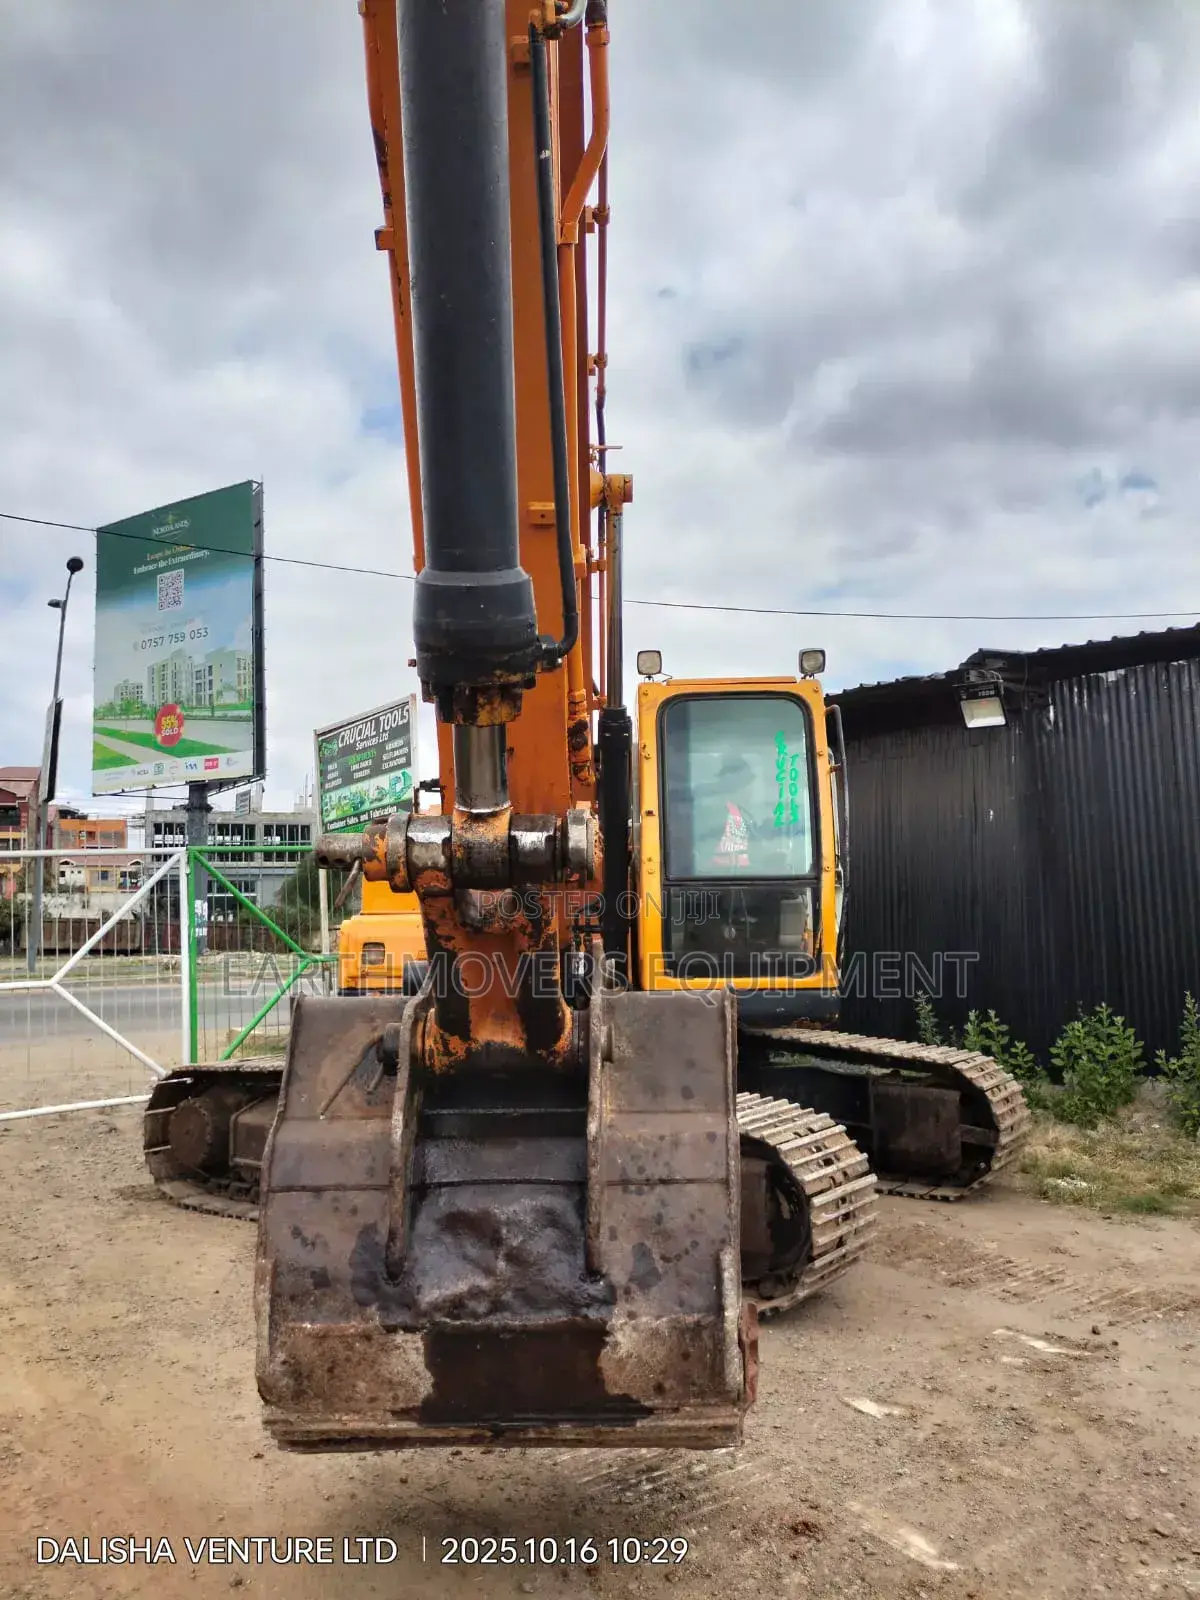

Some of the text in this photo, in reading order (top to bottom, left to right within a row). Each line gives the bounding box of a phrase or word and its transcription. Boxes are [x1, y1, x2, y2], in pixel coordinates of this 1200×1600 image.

[141, 626, 209, 650] 0757 759 053
[161, 727, 179, 737] SOLD
[338, 705, 410, 748] CRUCIAL TOOLS
[355, 736, 379, 751] Services
[379, 731, 389, 743] Ltd
[370, 804, 397, 819] Fabrication
